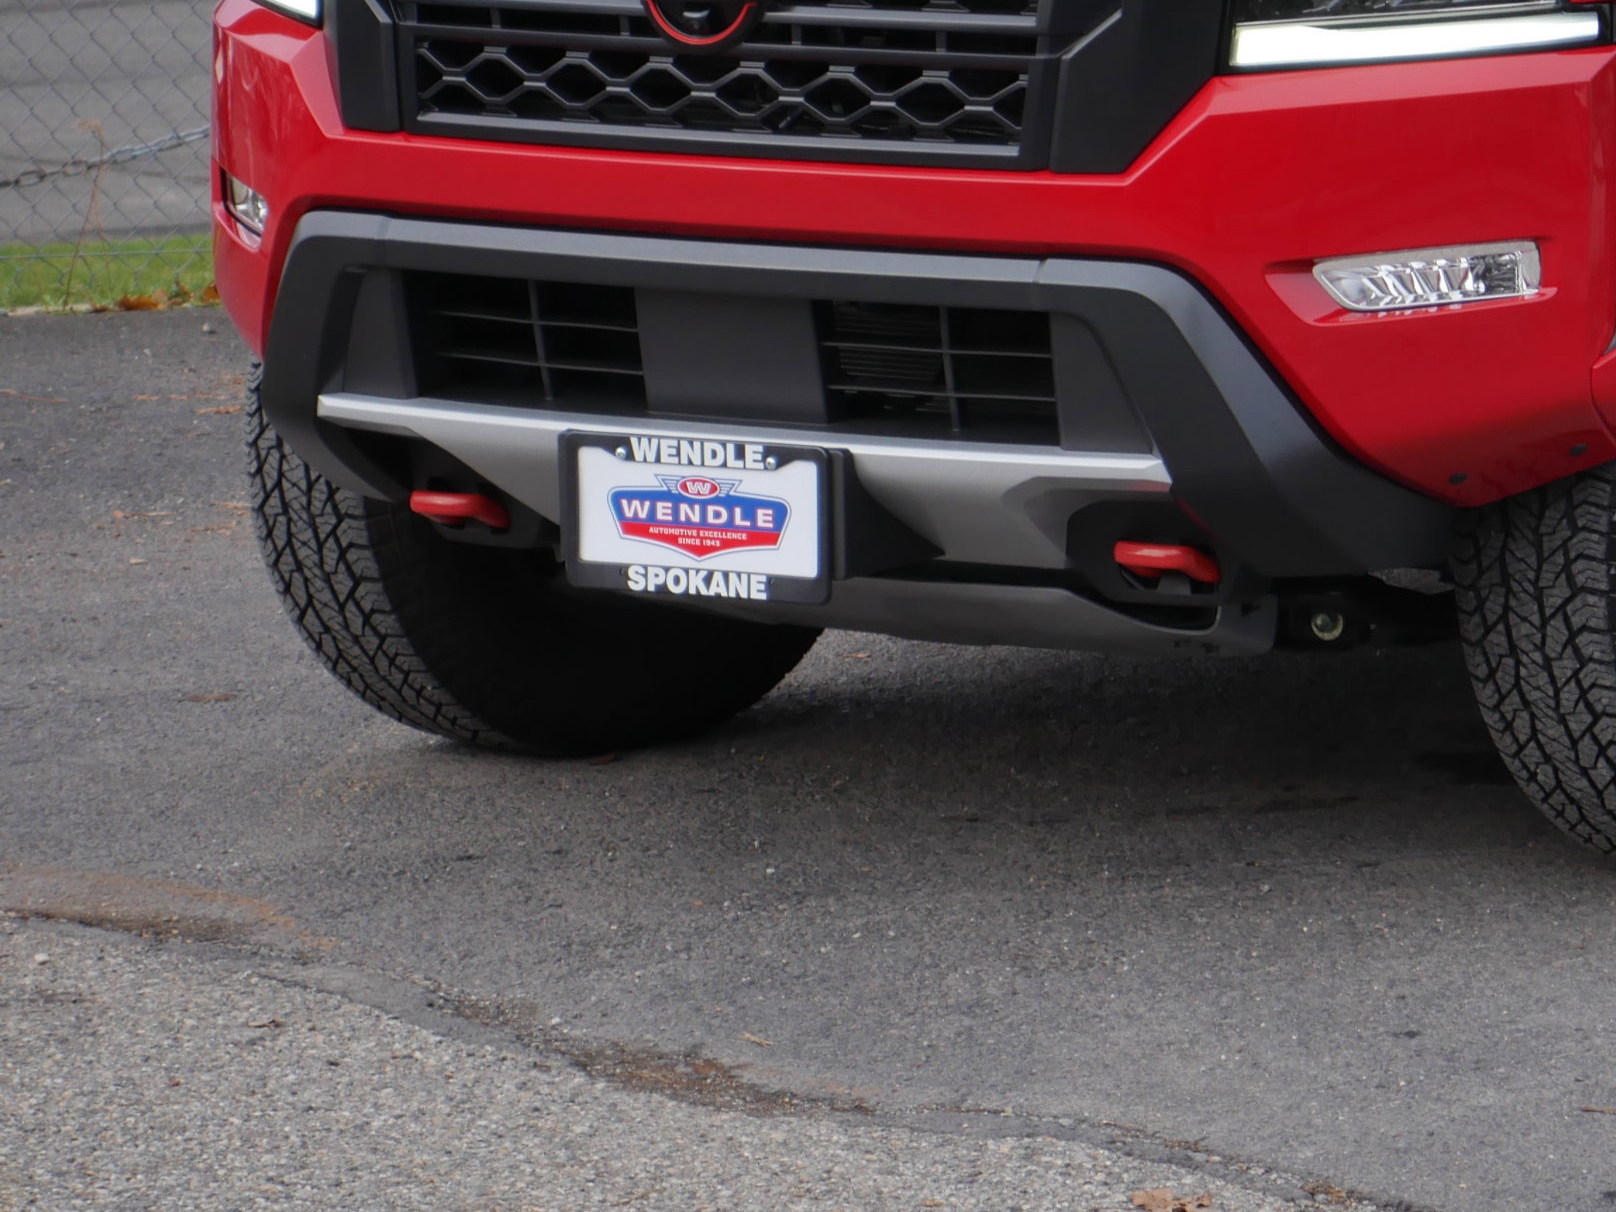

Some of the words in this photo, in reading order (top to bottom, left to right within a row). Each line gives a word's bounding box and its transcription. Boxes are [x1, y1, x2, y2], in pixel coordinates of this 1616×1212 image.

[629, 437, 765, 470] WENDLE
[620, 499, 774, 528] WENDLE
[649, 526, 697, 537] AUTOMOTIVE
[699, 529, 747, 540] EXCELLENCE
[678, 537, 700, 546] SINCE
[627, 564, 767, 600] SPOKANE
